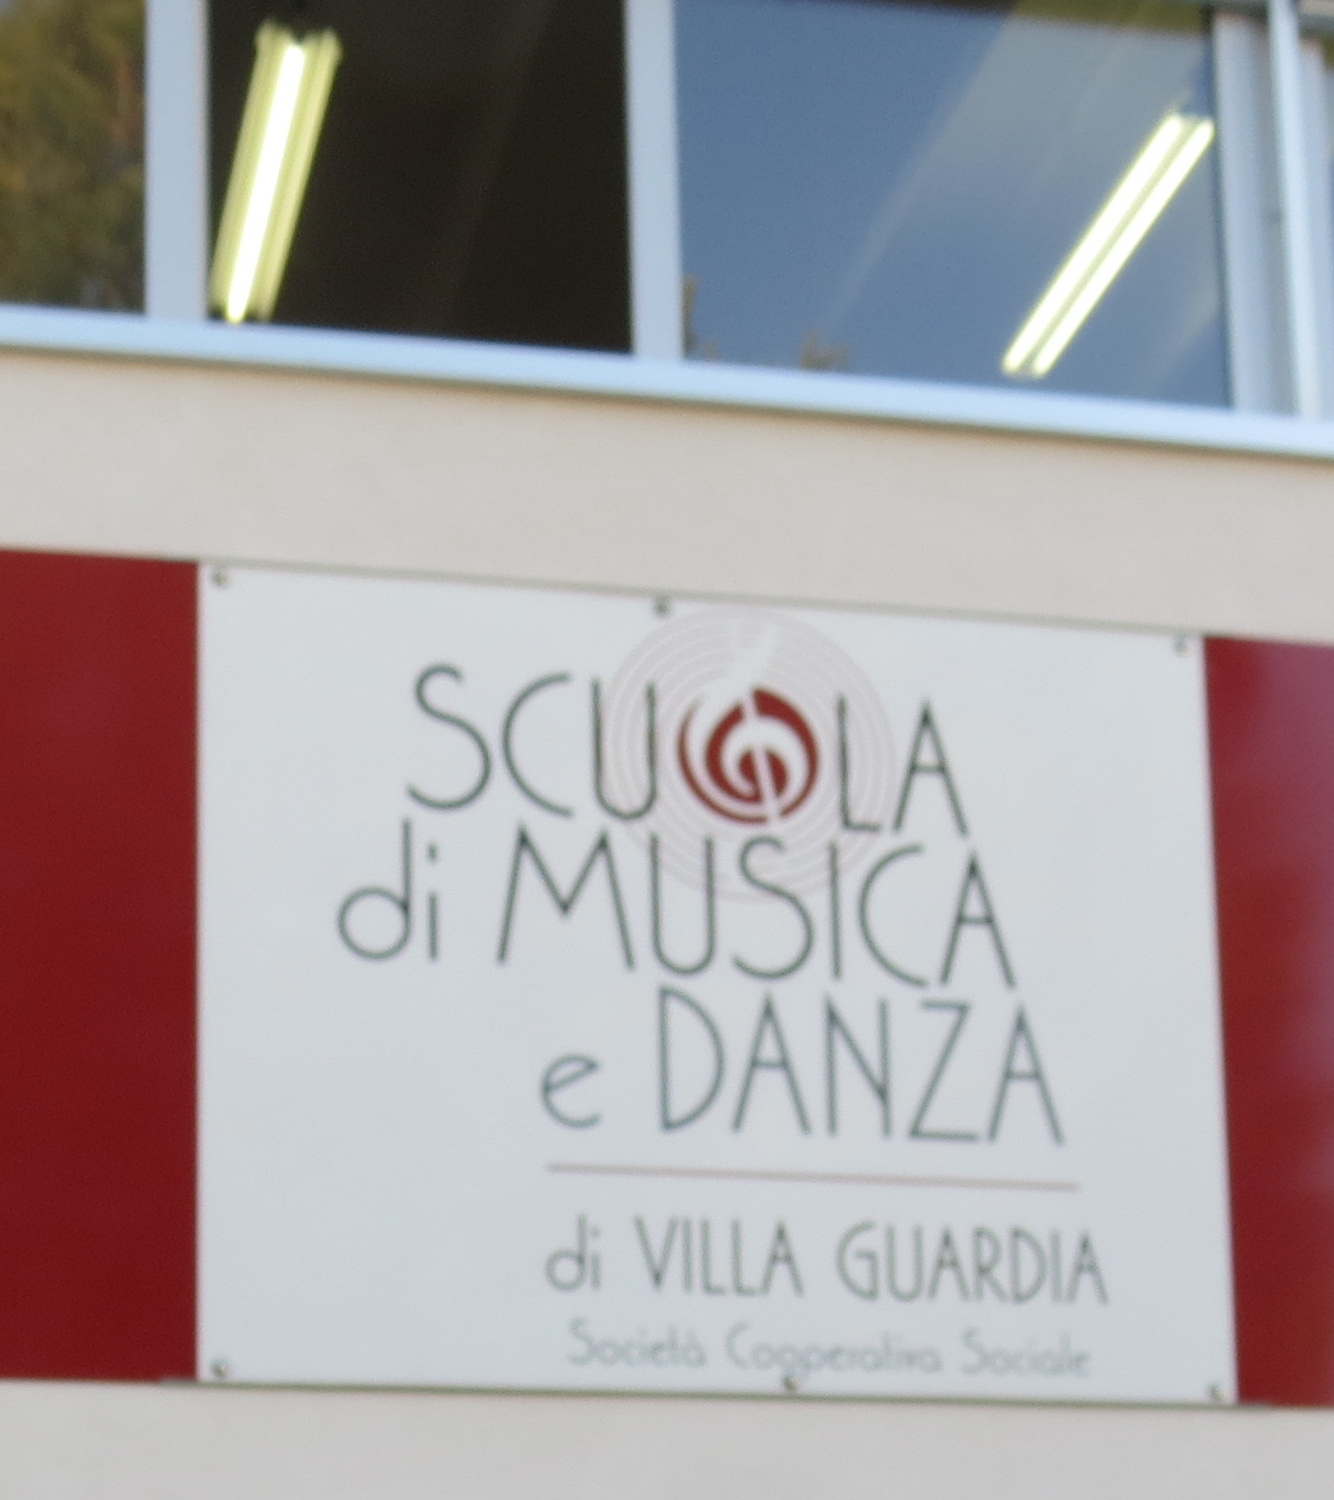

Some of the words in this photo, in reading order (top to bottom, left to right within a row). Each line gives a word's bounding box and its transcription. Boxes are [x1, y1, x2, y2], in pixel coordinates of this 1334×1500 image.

[406, 662, 970, 838] SCUOLA
[337, 817, 439, 963] di
[497, 822, 1016, 990] MUSICA
[540, 1053, 602, 1130] e
[658, 984, 1066, 1147] DANZA
[544, 1213, 602, 1292] di
[633, 1213, 805, 1298] VILLA
[834, 1219, 1110, 1306] GUARDIA
[724, 1321, 943, 1378] Cooperativa
[963, 1327, 1092, 1378] Sociale
